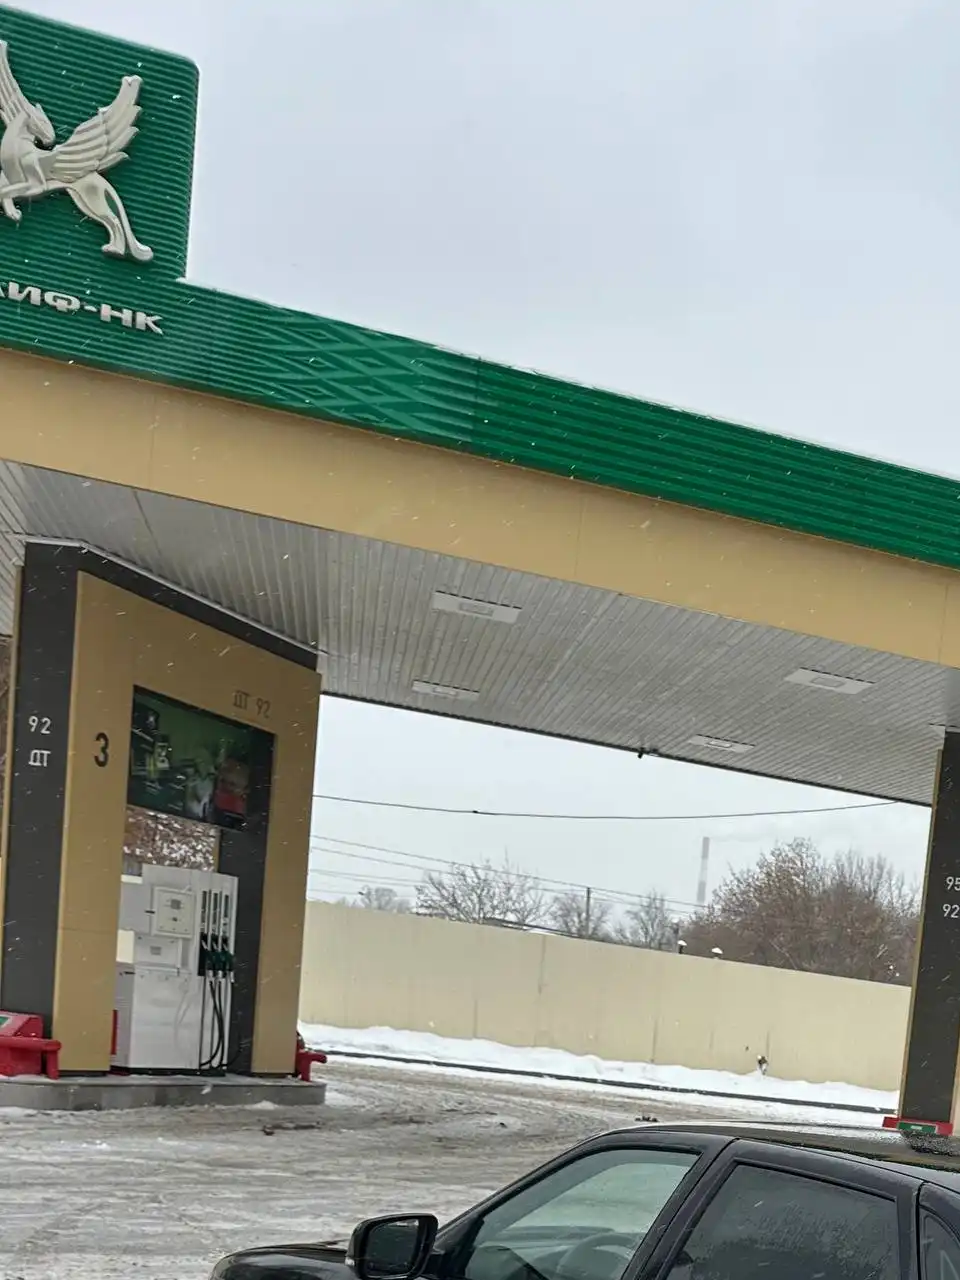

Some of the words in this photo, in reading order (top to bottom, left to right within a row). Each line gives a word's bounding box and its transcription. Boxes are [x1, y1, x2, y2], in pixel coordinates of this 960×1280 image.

[0, 282, 164, 335] ИФ-НК
[255, 698, 272, 719] 92
[28, 715, 51, 734] 92
[28, 749, 51, 767] ДТ
[94, 732, 109, 768] 3
[942, 903, 960, 919] 92
